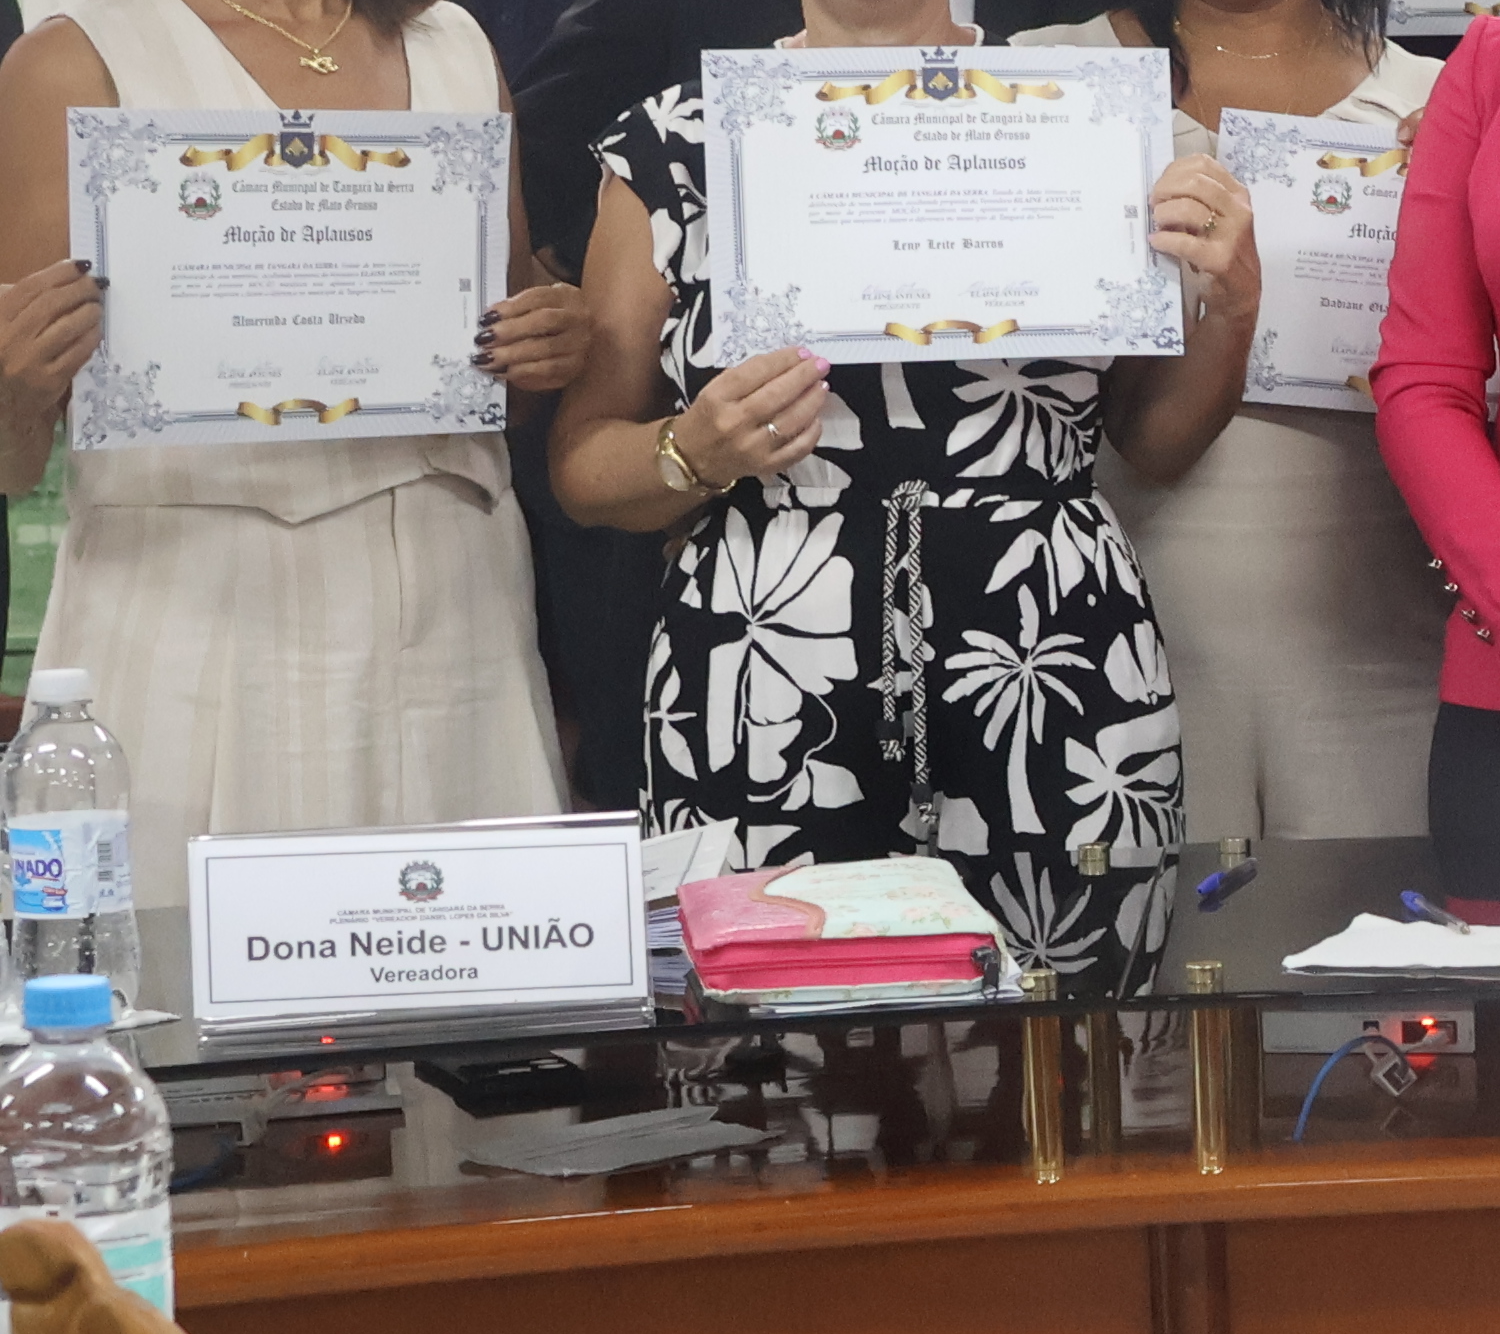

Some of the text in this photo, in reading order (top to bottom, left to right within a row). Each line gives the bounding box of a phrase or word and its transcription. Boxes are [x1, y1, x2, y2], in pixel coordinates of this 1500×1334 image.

[862, 154, 1026, 176] Moção de Aplausos
[1363, 184, 1398, 199] Câmara
[222, 225, 373, 248] Moção de Aplausos
[892, 237, 1004, 253] Leny Leite Barros
[247, 936, 336, 961] Dona
[351, 929, 447, 957] Neide
[481, 918, 594, 952] UNIÃO
[370, 965, 478, 984] Vereadora
